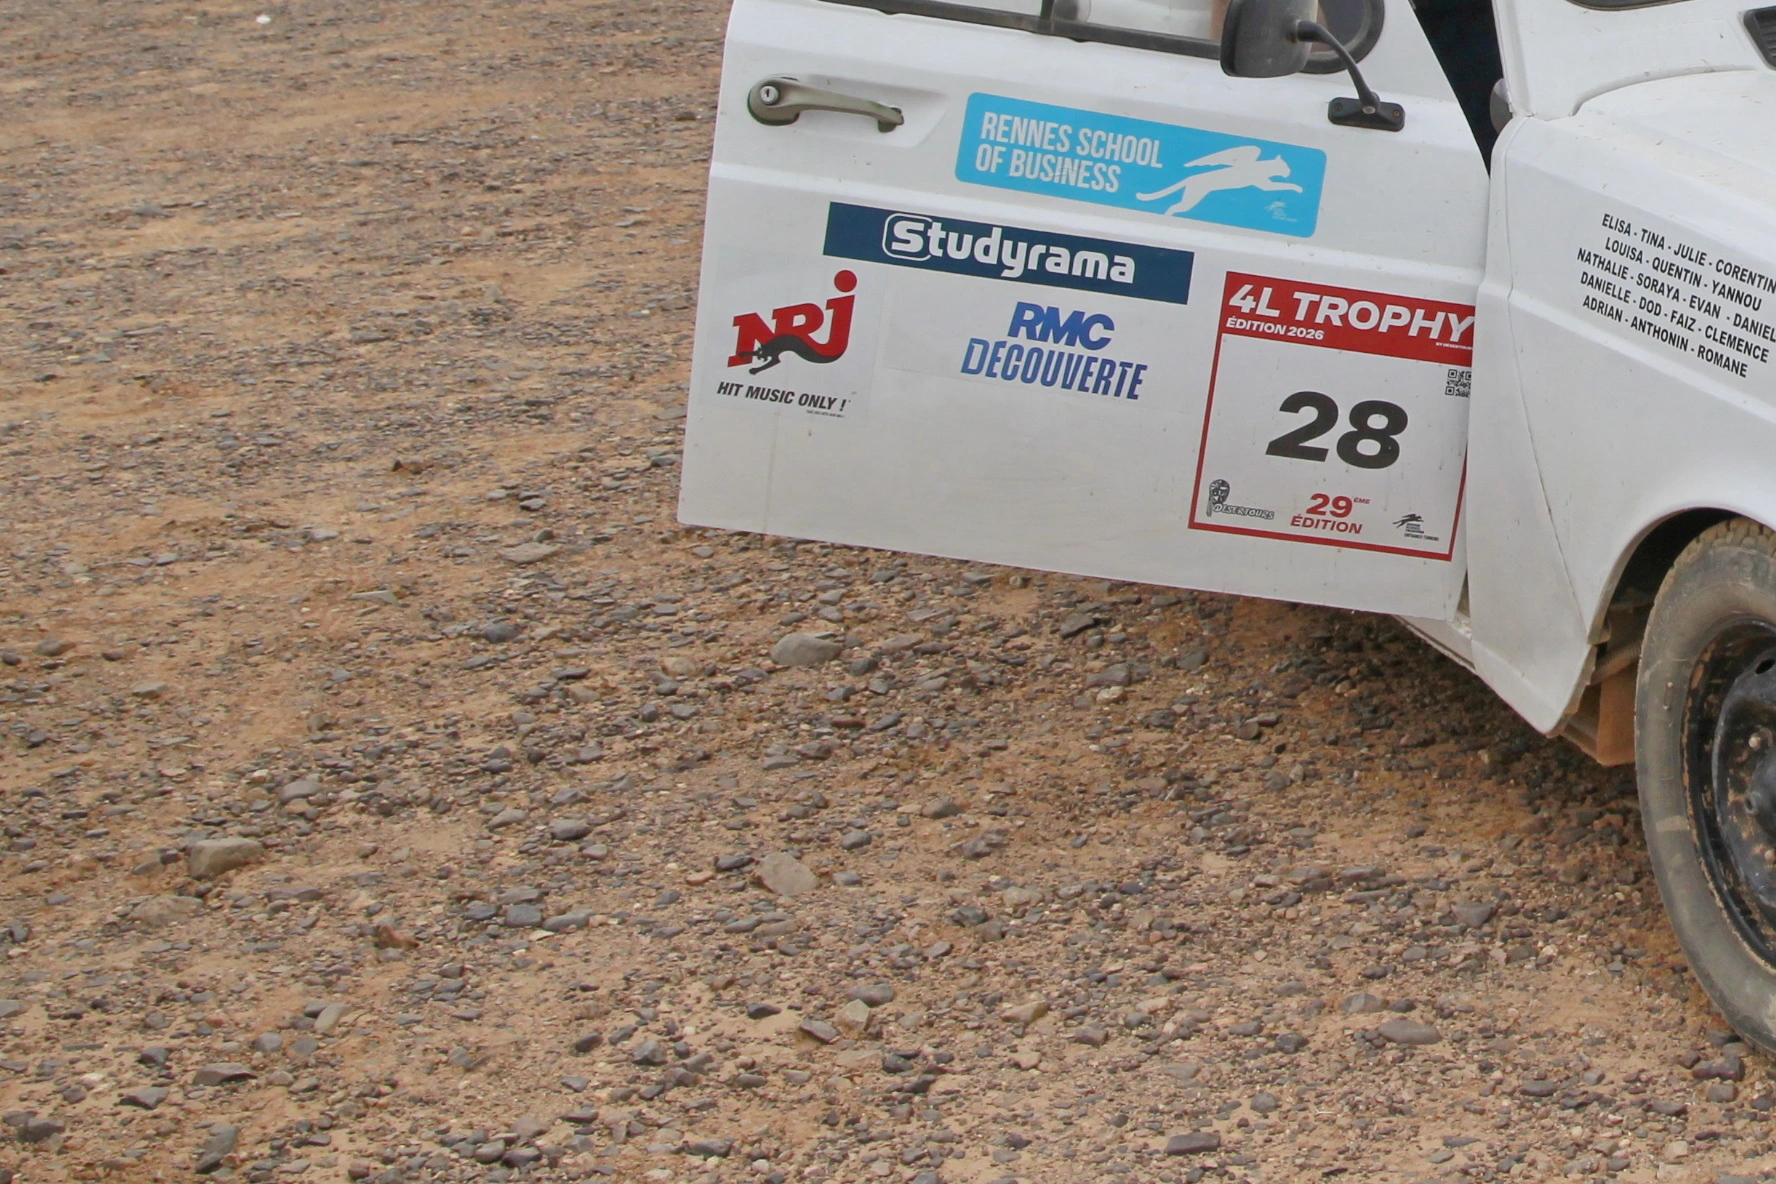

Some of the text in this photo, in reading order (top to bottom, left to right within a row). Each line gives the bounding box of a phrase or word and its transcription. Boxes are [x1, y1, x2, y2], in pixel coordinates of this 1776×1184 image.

[975, 142, 1122, 194] OF BUSINESS
[980, 111, 1163, 169] RENNES SCHOOL
[882, 213, 1136, 284] Studyrama
[1601, 213, 1632, 236] ELISA
[1640, 228, 1665, 250] TINA
[1673, 243, 1707, 266] JULIE
[1577, 248, 1629, 280] NATHALIE
[1636, 273, 1680, 302] SORAYA
[1688, 295, 1721, 319] EVAN
[1605, 237, 1762, 311] LOUISA QUENTIN YANNOU
[1007, 301, 1115, 351] RMC
[1226, 316, 1325, 341] ÉDITION 2026
[1228, 284, 1475, 343] 4L TROPHY
[1580, 271, 1769, 363] DANIELLE DOD FAIZ CLEMENCE
[1582, 295, 1748, 378] ADRIAN ANTHONIN ROMANE
[717, 381, 744, 397] HIT
[745, 385, 796, 405] MUSIC
[797, 392, 838, 411] ONLY
[1265, 390, 1409, 470] 28
[1290, 513, 1363, 535] ÉDITION
